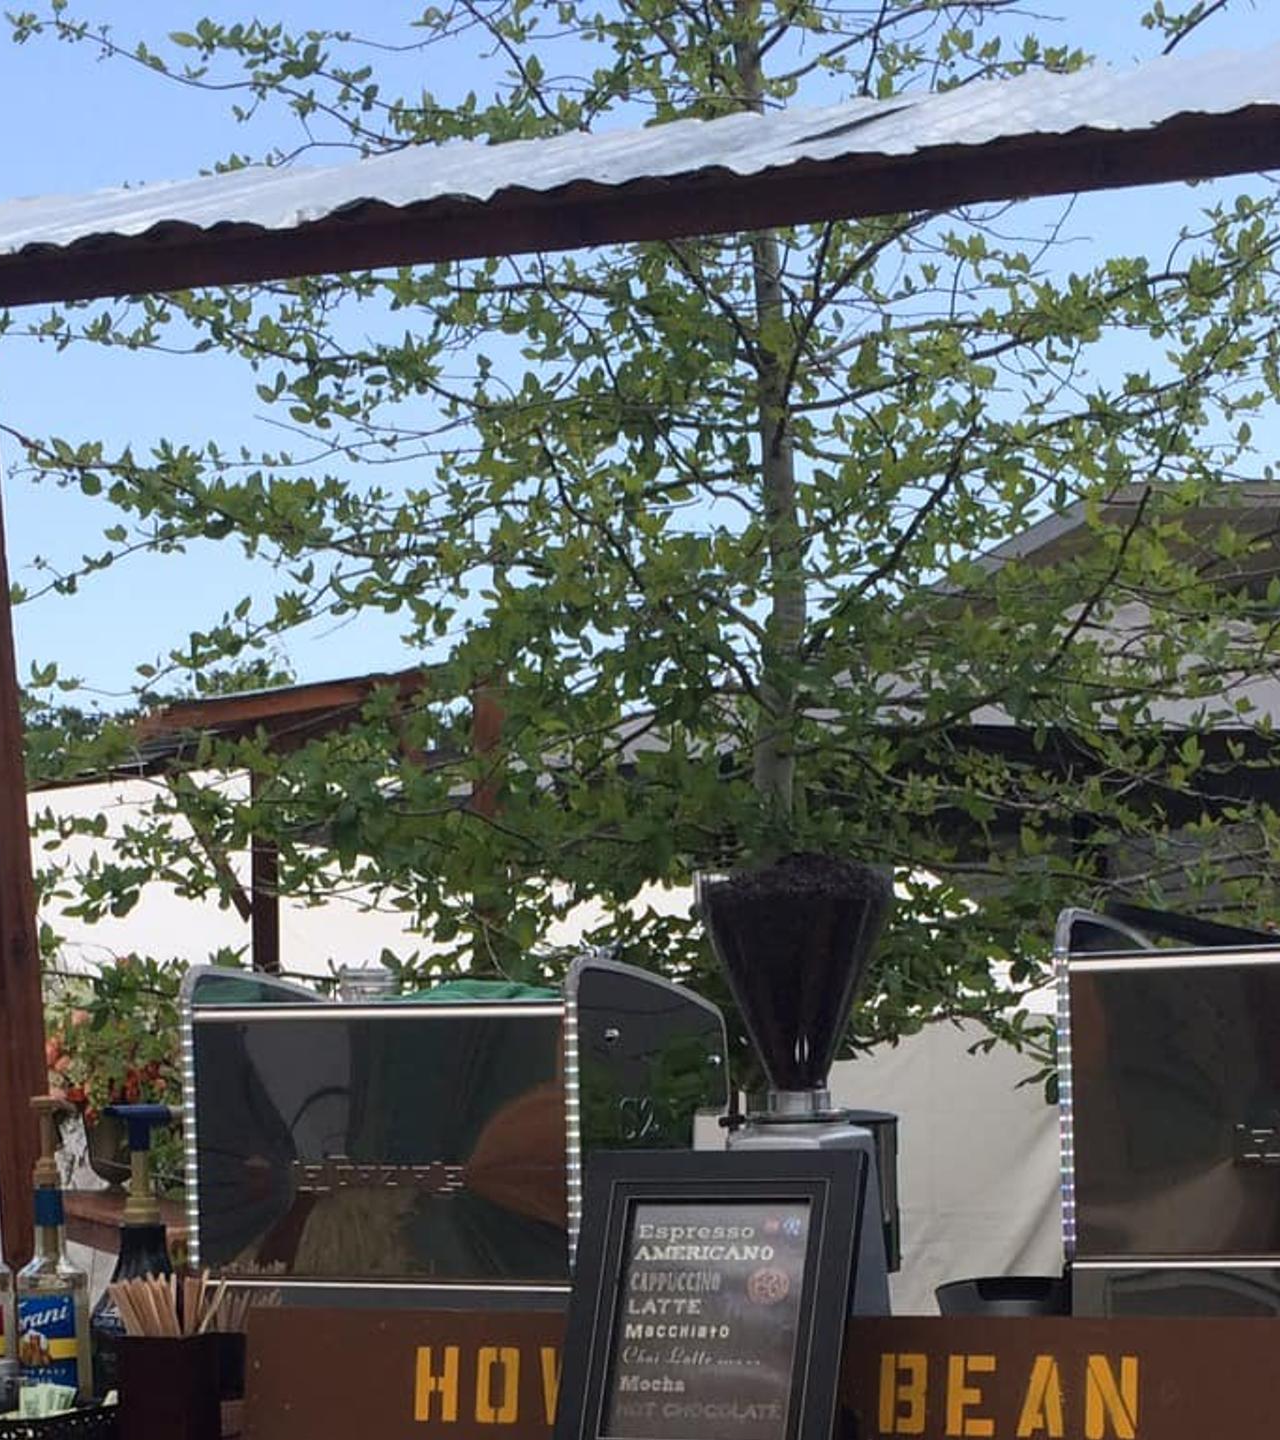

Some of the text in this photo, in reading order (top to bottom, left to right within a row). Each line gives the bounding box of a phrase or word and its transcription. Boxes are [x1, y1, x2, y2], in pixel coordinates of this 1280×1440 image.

[638, 1224, 755, 1242] Espresso
[633, 1245, 774, 1261] AMERICANO
[630, 1270, 721, 1292] CAPPUCCINO
[628, 1299, 701, 1316] LATTE
[619, 1376, 686, 1393] Mocha
[877, 1352, 1140, 1440] BEAN
